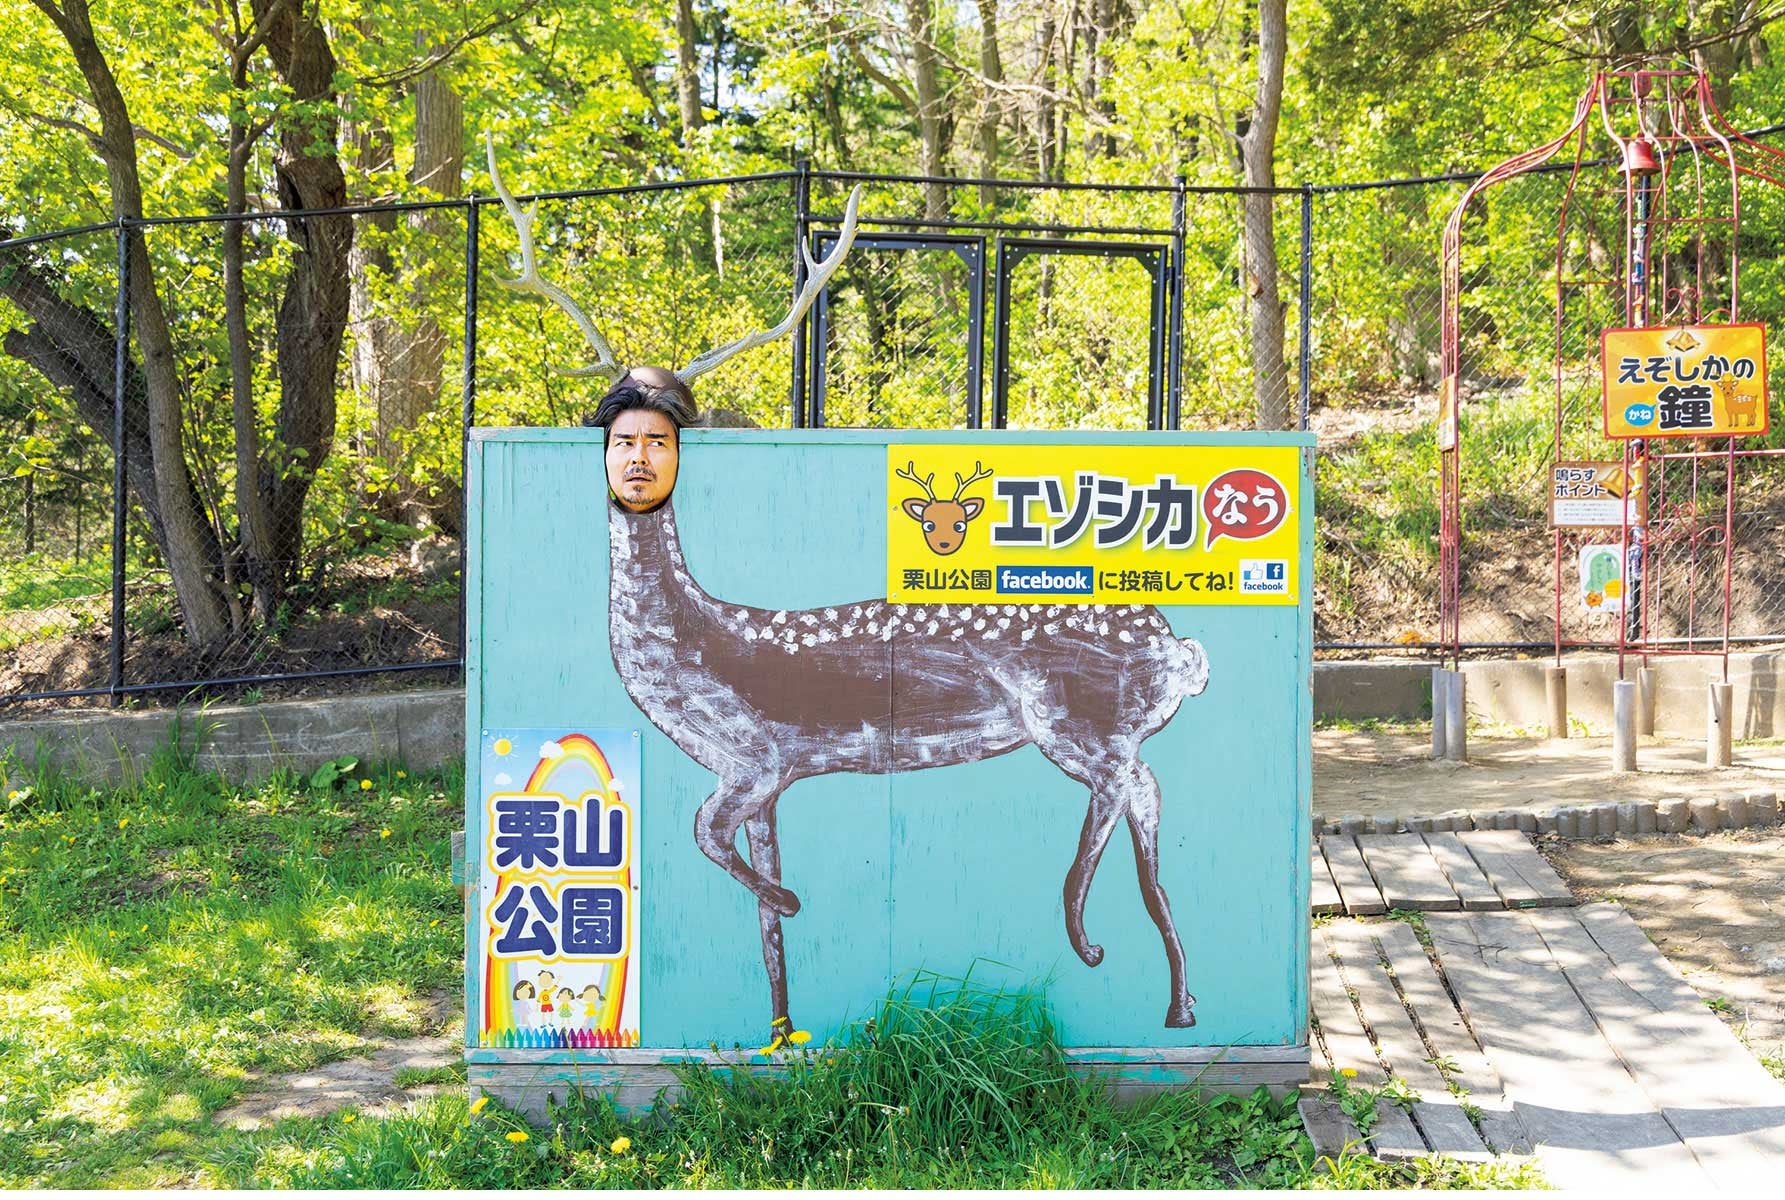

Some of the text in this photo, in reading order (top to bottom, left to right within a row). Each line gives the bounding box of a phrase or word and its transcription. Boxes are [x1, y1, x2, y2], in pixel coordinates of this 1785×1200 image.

[1618, 355, 1755, 383] えぞしかの
[1628, 409, 1652, 420] かね
[1658, 384, 1713, 428] 鐘
[1555, 469, 1595, 481] 鳴らす
[1212, 483, 1279, 526] なう
[1555, 484, 1606, 497] ポイント
[994, 475, 1194, 545] エゾシカ
[902, 569, 992, 591] 栗山公園
[1243, 581, 1284, 591] facebook
[495, 798, 623, 869] 栗山
[495, 885, 623, 956] 公園
